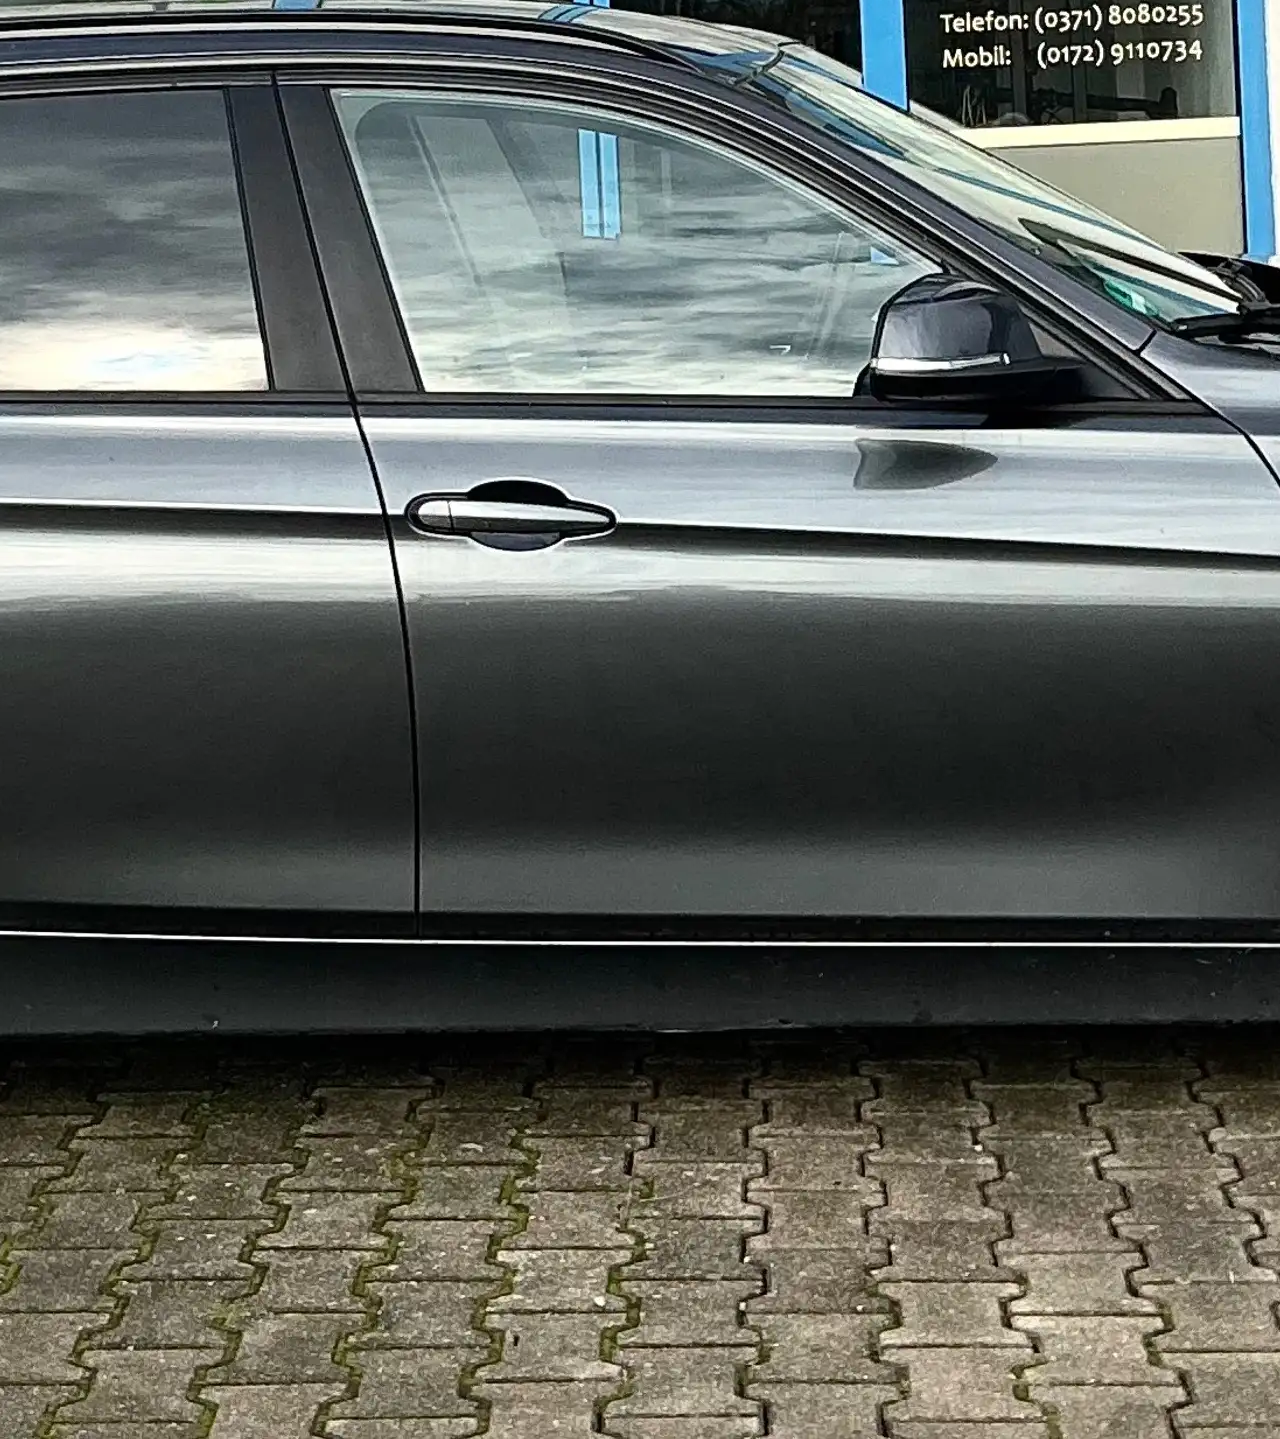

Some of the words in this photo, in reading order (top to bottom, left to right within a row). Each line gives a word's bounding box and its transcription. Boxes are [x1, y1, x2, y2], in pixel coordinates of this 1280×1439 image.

[940, 10, 1030, 34] Telefon:
[1034, 4, 1103, 35] (0371)
[1108, 3, 1204, 27] 8080255
[942, 46, 1012, 69] Mobil:
[1037, 40, 1104, 70] (0172)
[1111, 39, 1203, 66] 9110734
